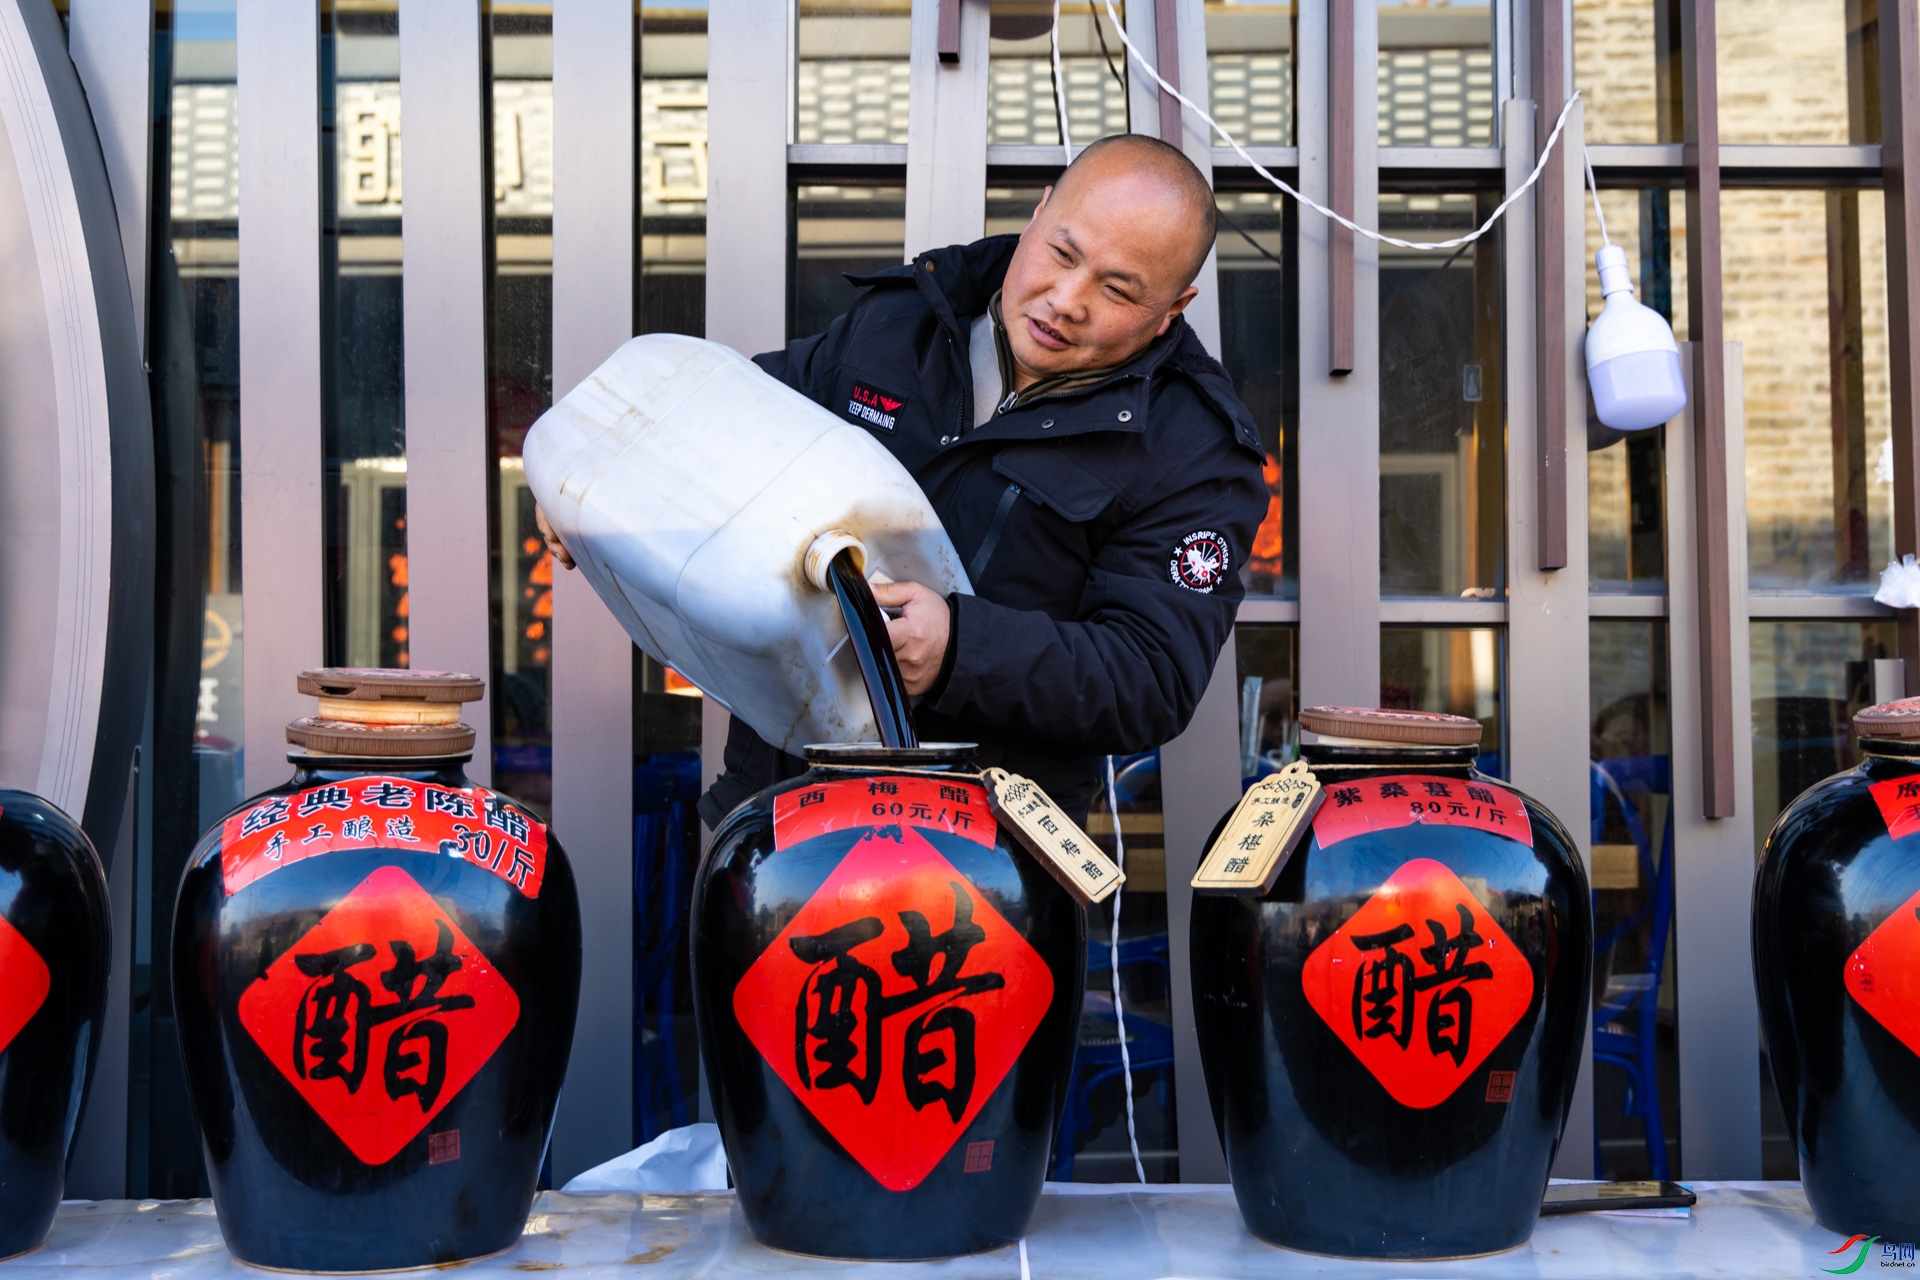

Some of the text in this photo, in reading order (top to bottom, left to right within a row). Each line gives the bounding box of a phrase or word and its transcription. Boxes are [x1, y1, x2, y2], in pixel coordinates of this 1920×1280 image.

[1183, 531, 1217, 545] INSRIPE
[798, 782, 970, 809] 西梅醋
[1333, 782, 1496, 808] 紫桑葚醋
[241, 782, 530, 845] 经典老陈醋
[872, 803, 974, 830] 60元/斤
[1410, 801, 1507, 825] 80元/斤
[265, 816, 420, 860] 手工酿造
[789, 881, 1005, 1124] 醋
[1350, 903, 1493, 1068] 醋
[293, 918, 475, 1114] 醋
